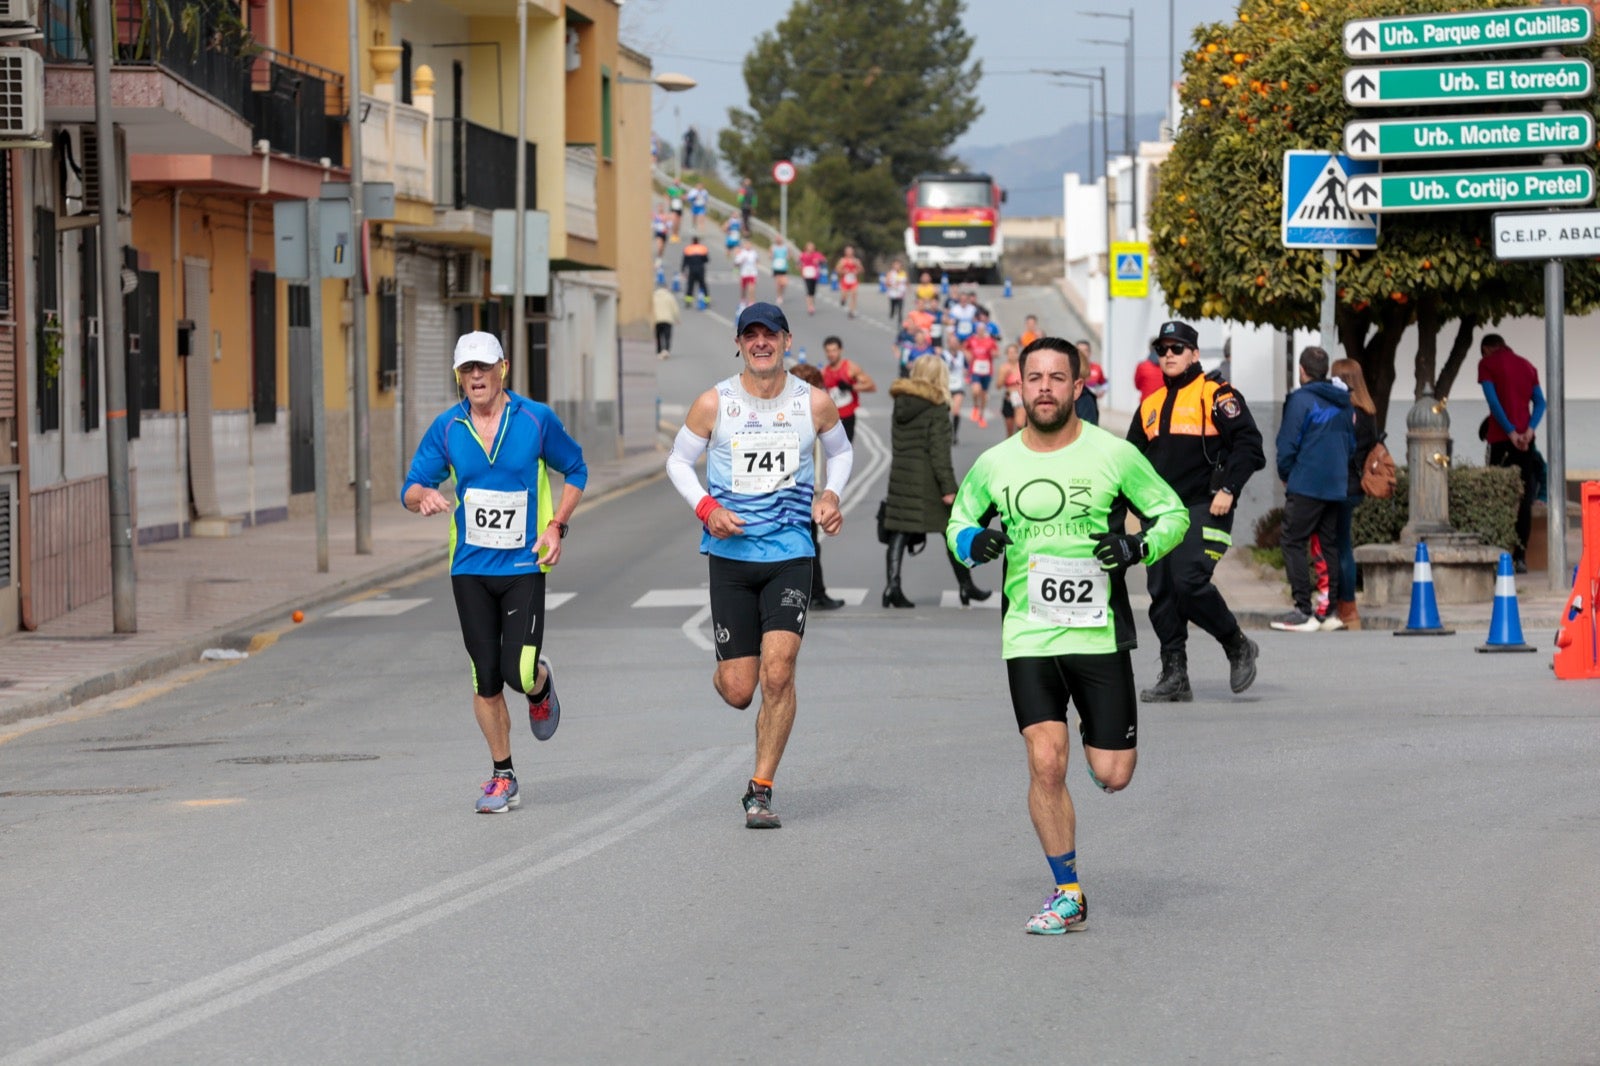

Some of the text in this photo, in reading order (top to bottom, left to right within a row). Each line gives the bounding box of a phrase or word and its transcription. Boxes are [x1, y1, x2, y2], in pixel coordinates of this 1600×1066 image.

[1384, 15, 1580, 46] Urb. Parque del Cubillas
[1439, 67, 1580, 92] Urb. El torreón
[1413, 122, 1580, 147] Urb. Monte Elvira
[1409, 175, 1582, 201] Urb. Cortijo Pretel
[1500, 229, 1552, 243] C.E.I.P.
[743, 451, 785, 473] 741
[1002, 478, 1066, 526] 10
[475, 508, 516, 529] 627
[1041, 578, 1093, 604] 662
